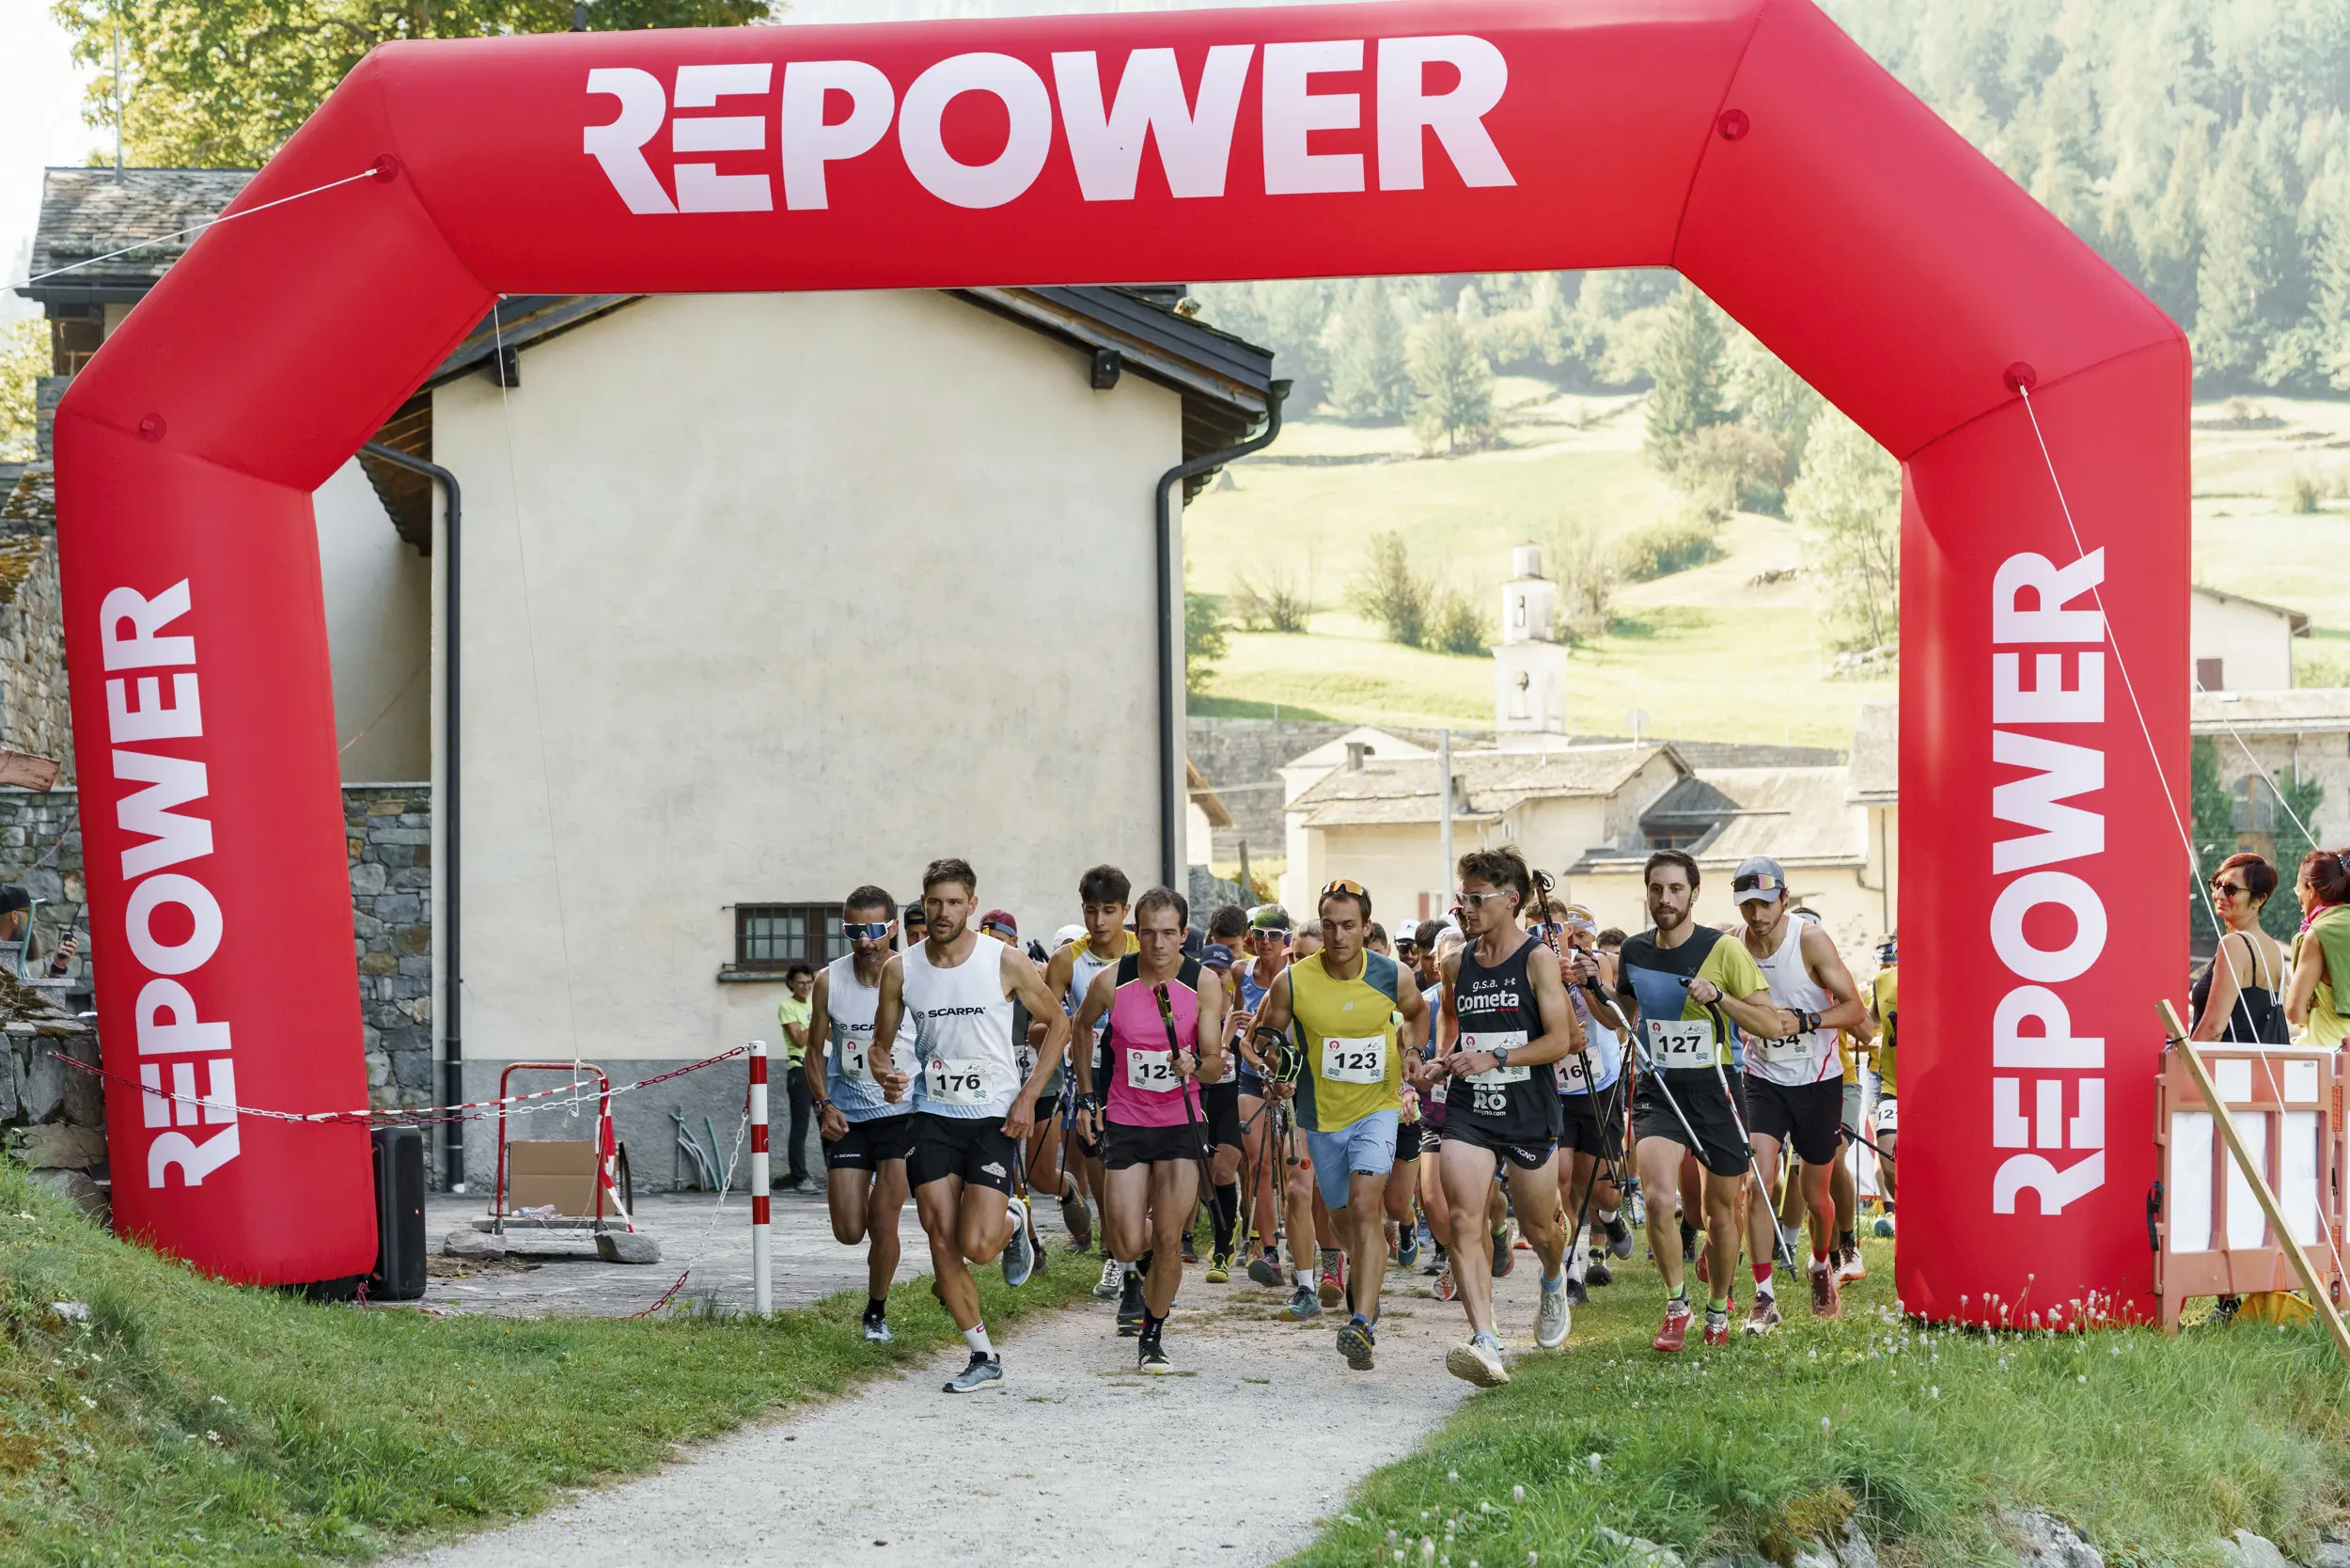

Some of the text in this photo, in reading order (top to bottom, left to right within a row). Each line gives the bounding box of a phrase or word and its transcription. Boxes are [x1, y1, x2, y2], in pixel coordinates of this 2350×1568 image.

[584, 35, 1517, 214] REPOWER
[100, 577, 241, 1188] REPOWER
[1990, 546, 2107, 1215] REPOWER
[1472, 979, 1498, 992] g.s.a.
[1457, 990, 1519, 1012] Cometa
[928, 1007, 984, 1018] SCARPA
[1658, 1035, 1701, 1053] 127
[1334, 1052, 1377, 1070] 123
[936, 1074, 980, 1091] 176
